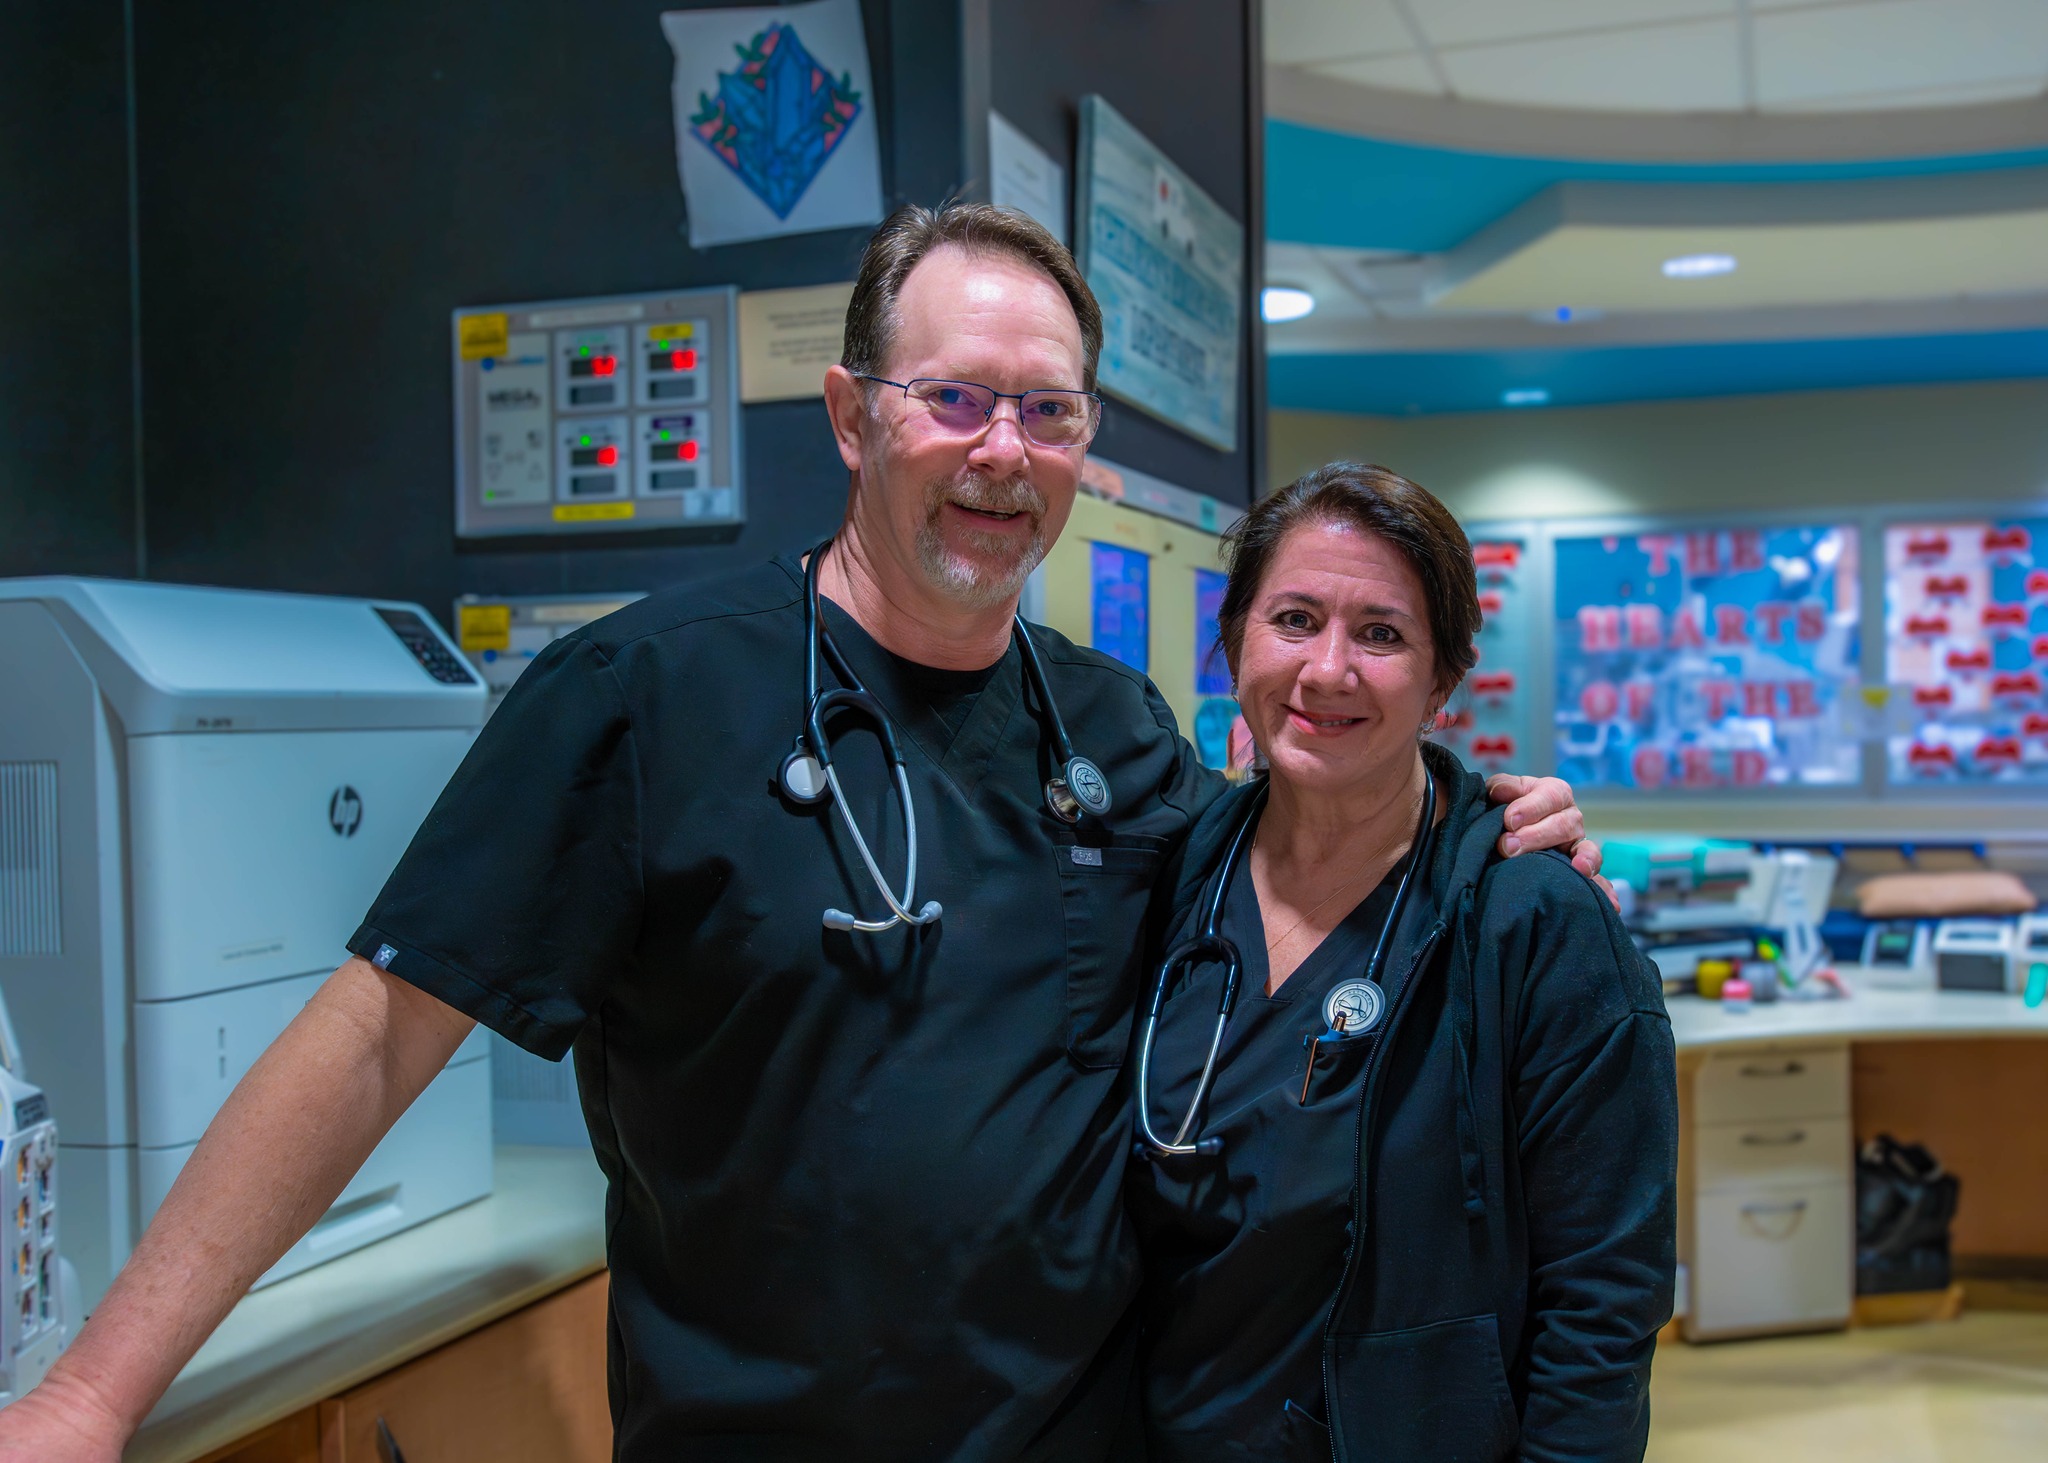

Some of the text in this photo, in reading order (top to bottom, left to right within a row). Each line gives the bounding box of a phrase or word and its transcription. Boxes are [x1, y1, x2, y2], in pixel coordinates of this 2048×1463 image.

[1638, 530, 1763, 575] THE
[1580, 605, 1825, 651] HEARTS
[1582, 681, 1820, 722] OF THE
